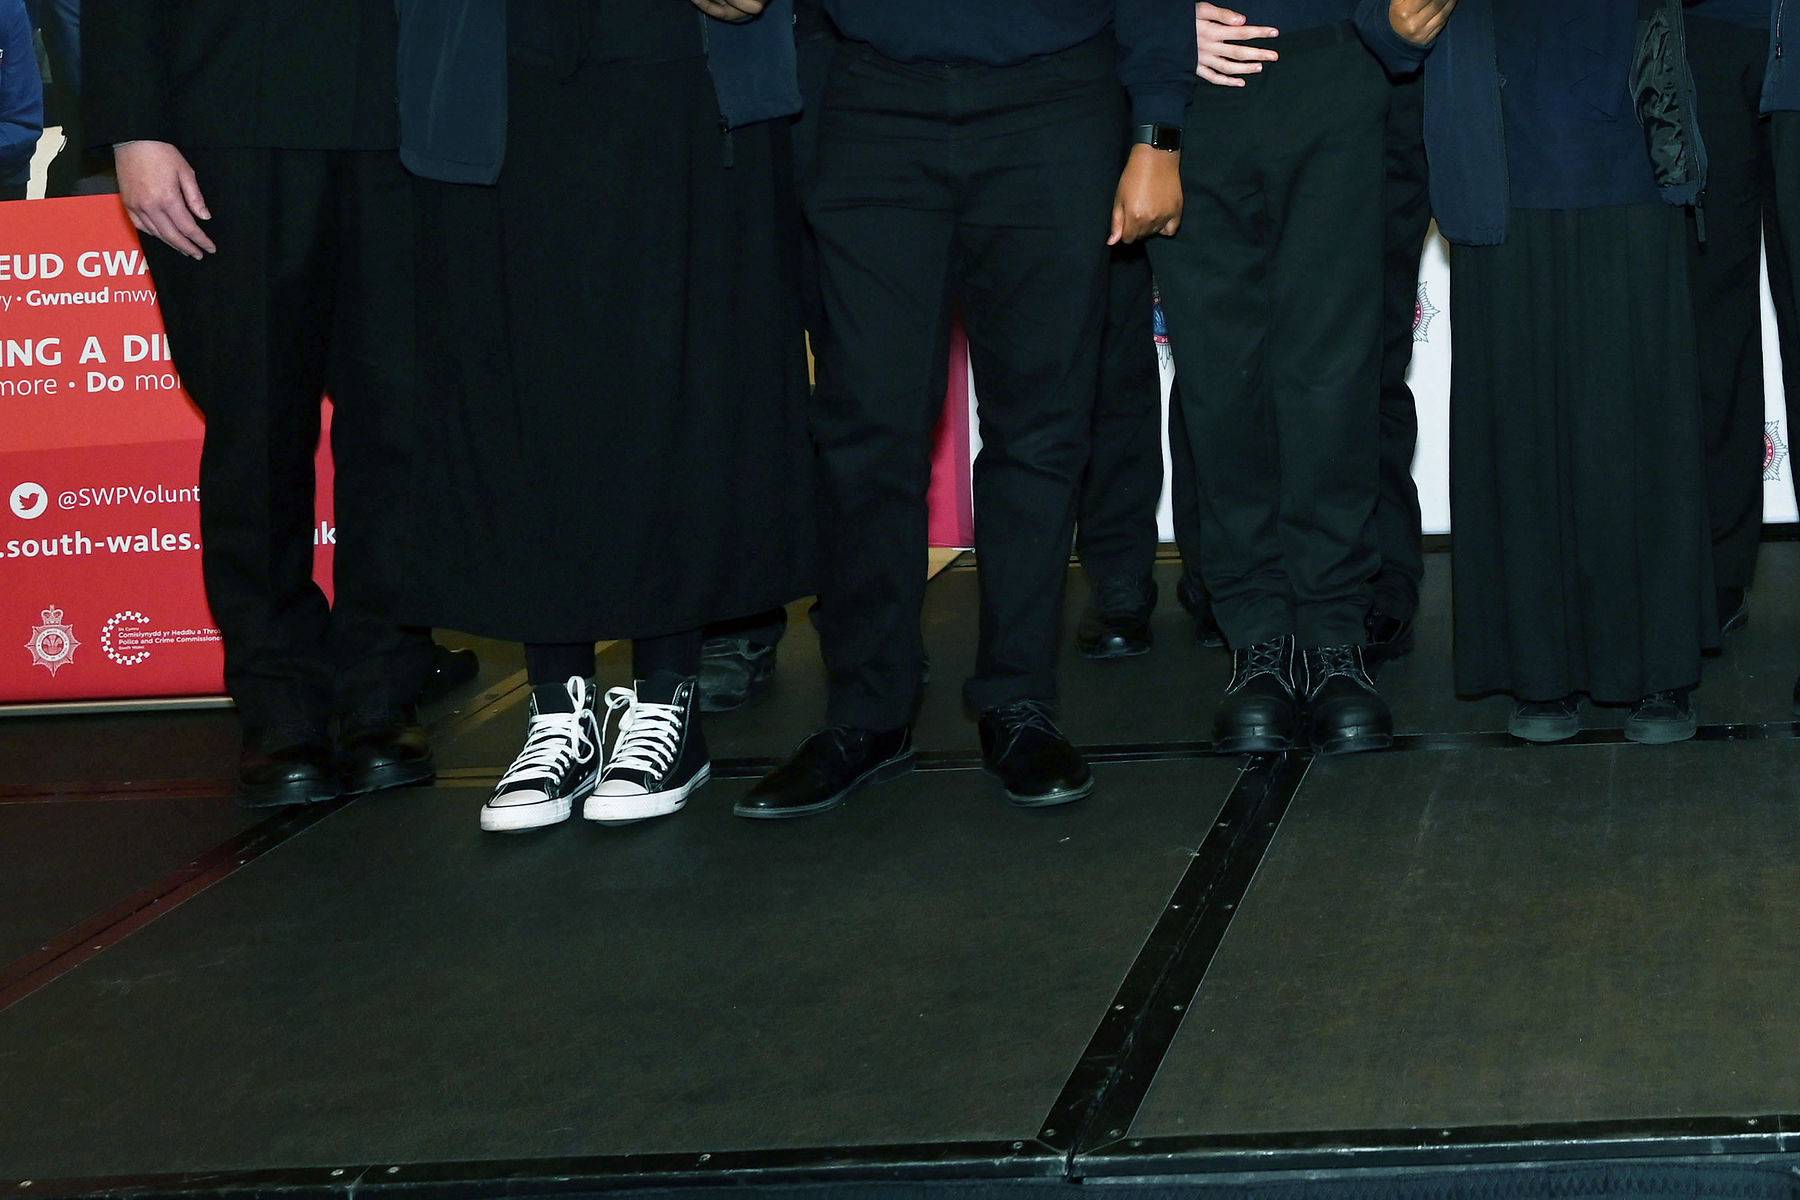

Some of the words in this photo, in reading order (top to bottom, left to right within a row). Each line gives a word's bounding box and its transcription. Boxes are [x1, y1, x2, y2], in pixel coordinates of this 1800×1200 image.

[0, 253, 64, 281] EUD
[0, 294, 12, 311] y
[26, 286, 109, 306] Gwneud
[114, 289, 157, 306] mwy
[79, 336, 107, 364] A
[87, 371, 125, 393] Do
